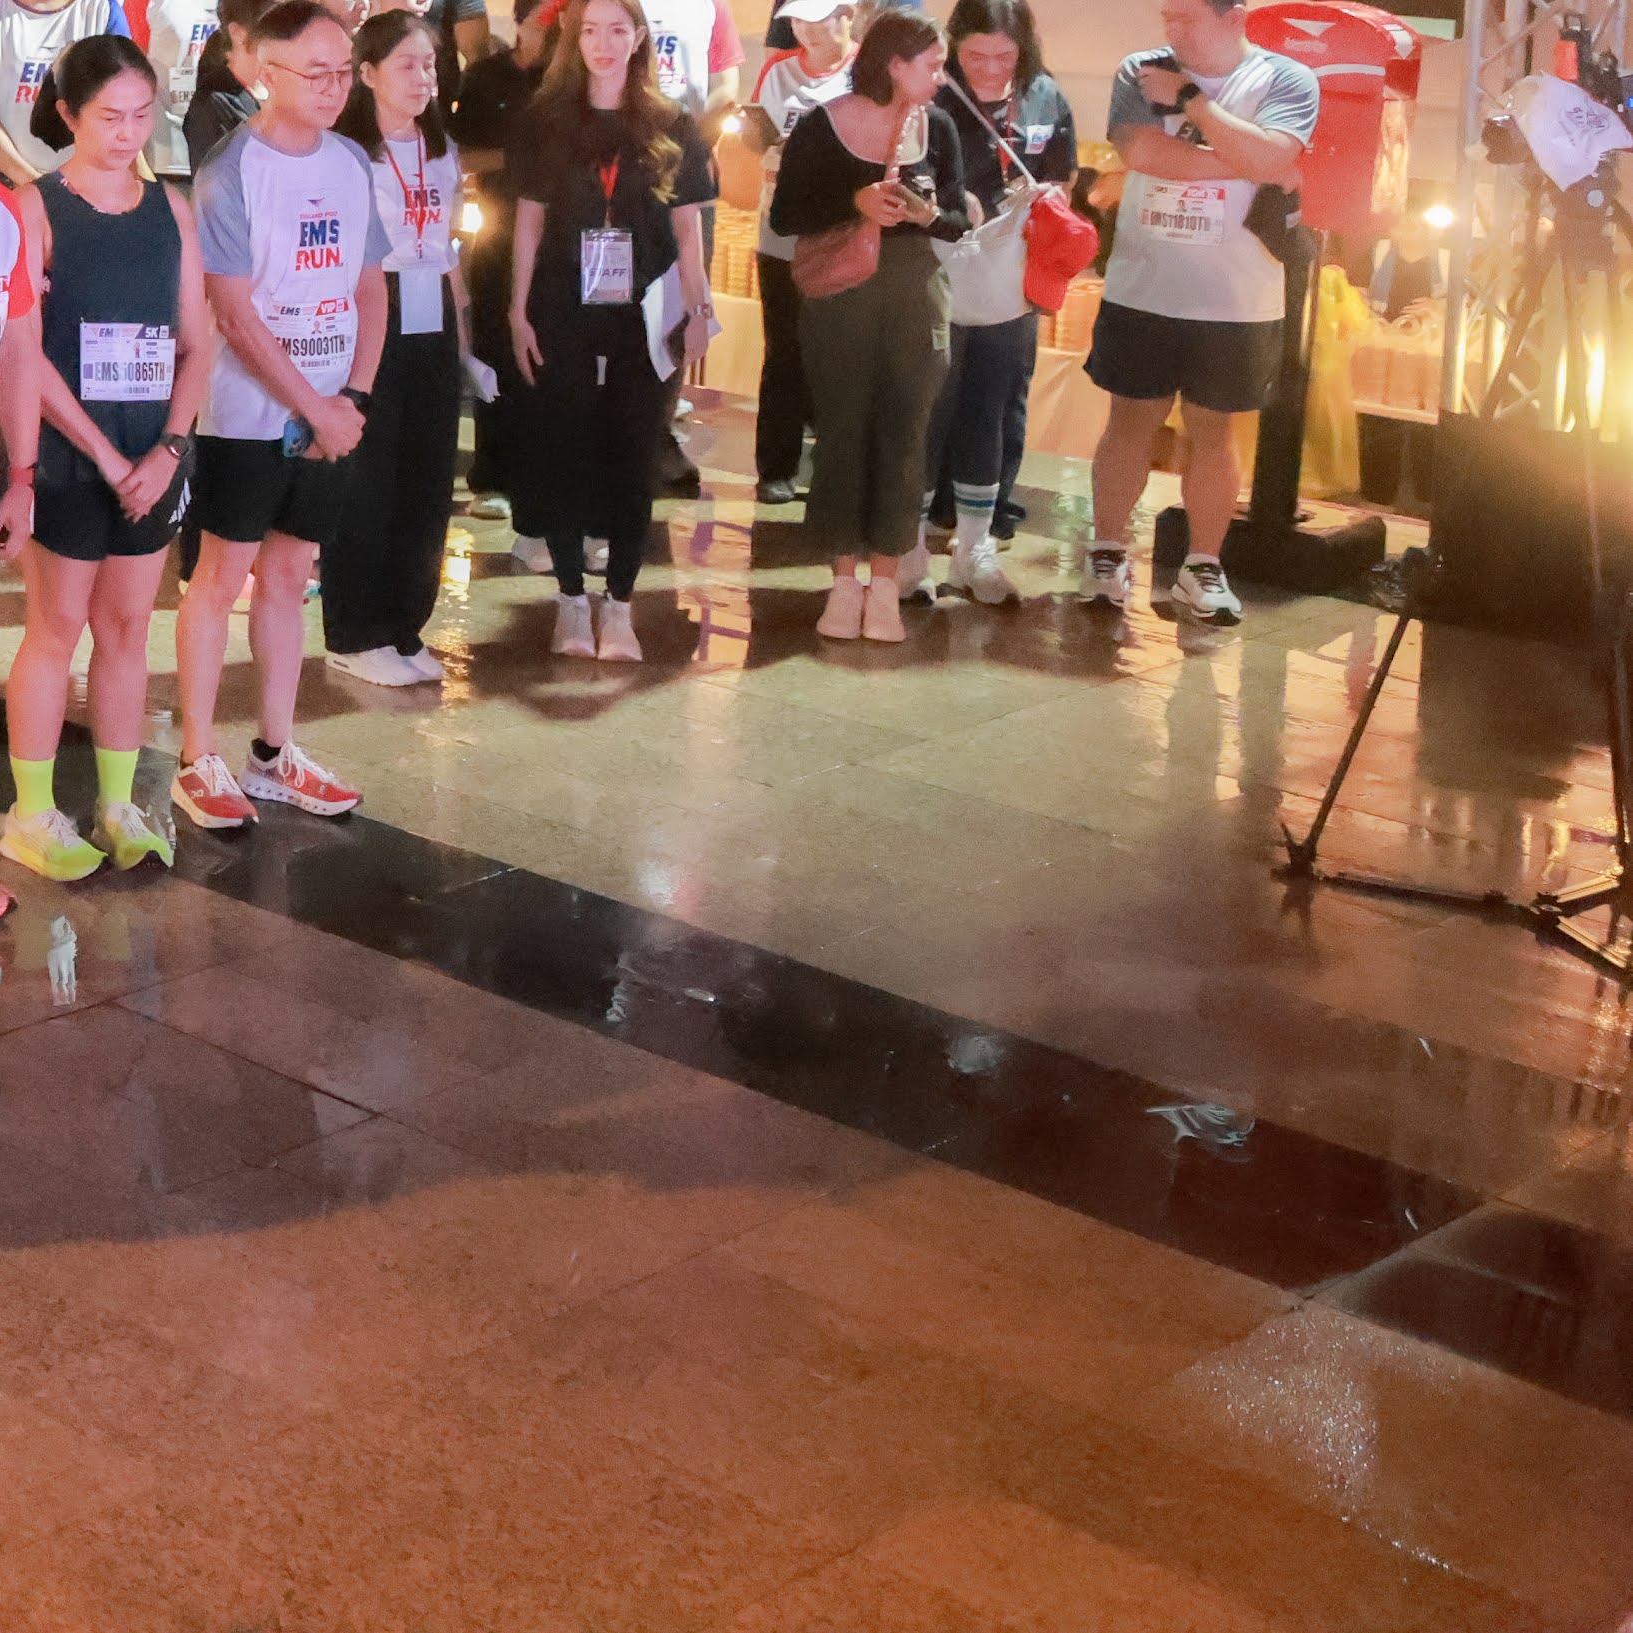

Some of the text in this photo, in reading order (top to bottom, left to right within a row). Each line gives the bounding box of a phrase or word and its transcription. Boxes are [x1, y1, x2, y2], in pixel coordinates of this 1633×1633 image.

[299, 219, 340, 247] EMS
[295, 246, 341, 271] RUN
[280, 303, 335, 316] EMS VIP
[145, 326, 159, 339] 5K
[276, 334, 345, 356] MS90031TH
[95, 362, 165, 382] EMS0865TH
